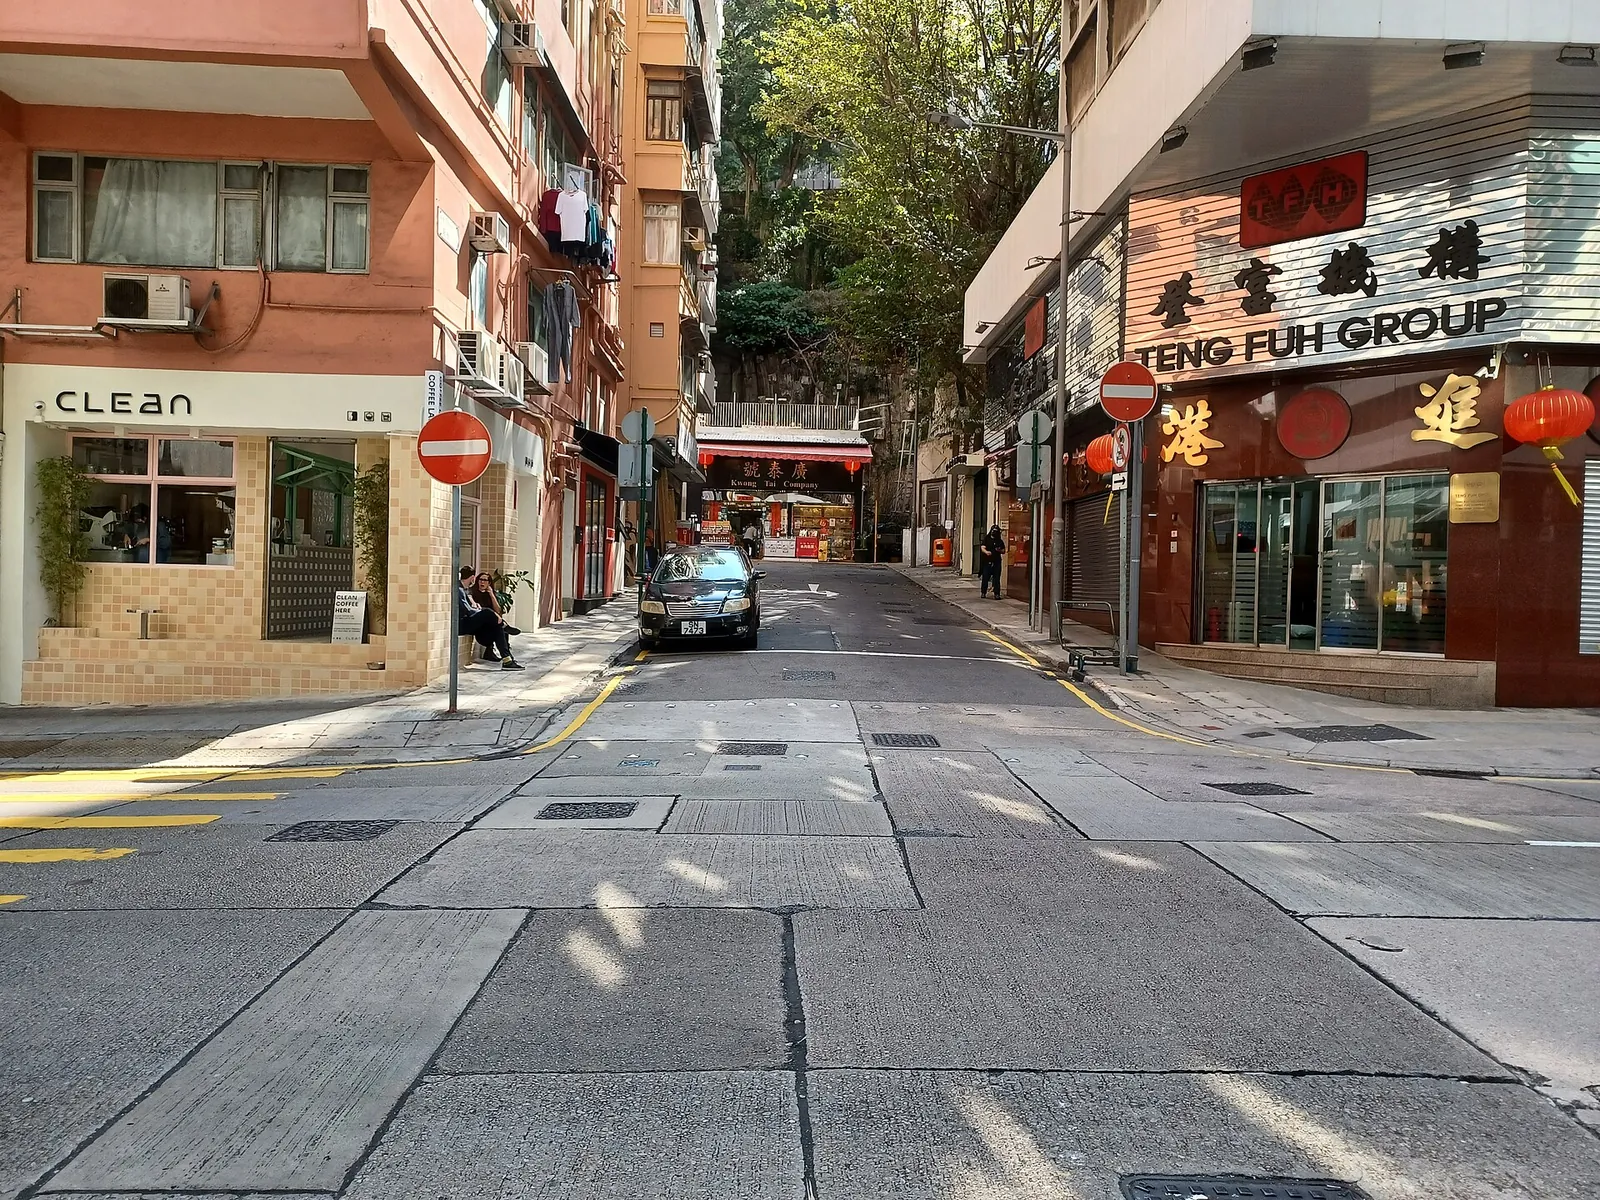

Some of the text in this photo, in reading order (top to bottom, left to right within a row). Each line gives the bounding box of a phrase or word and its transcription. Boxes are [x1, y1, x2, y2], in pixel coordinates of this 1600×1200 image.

[1251, 181, 1344, 219] TFH
[1150, 219, 1491, 329] 登富機構
[1135, 298, 1507, 372] TENG FUH GROUP
[428, 374, 436, 405] COFFEE
[1411, 373, 1498, 449] 進
[731, 479, 757, 488] Kwong
[783, 480, 819, 489] Company
